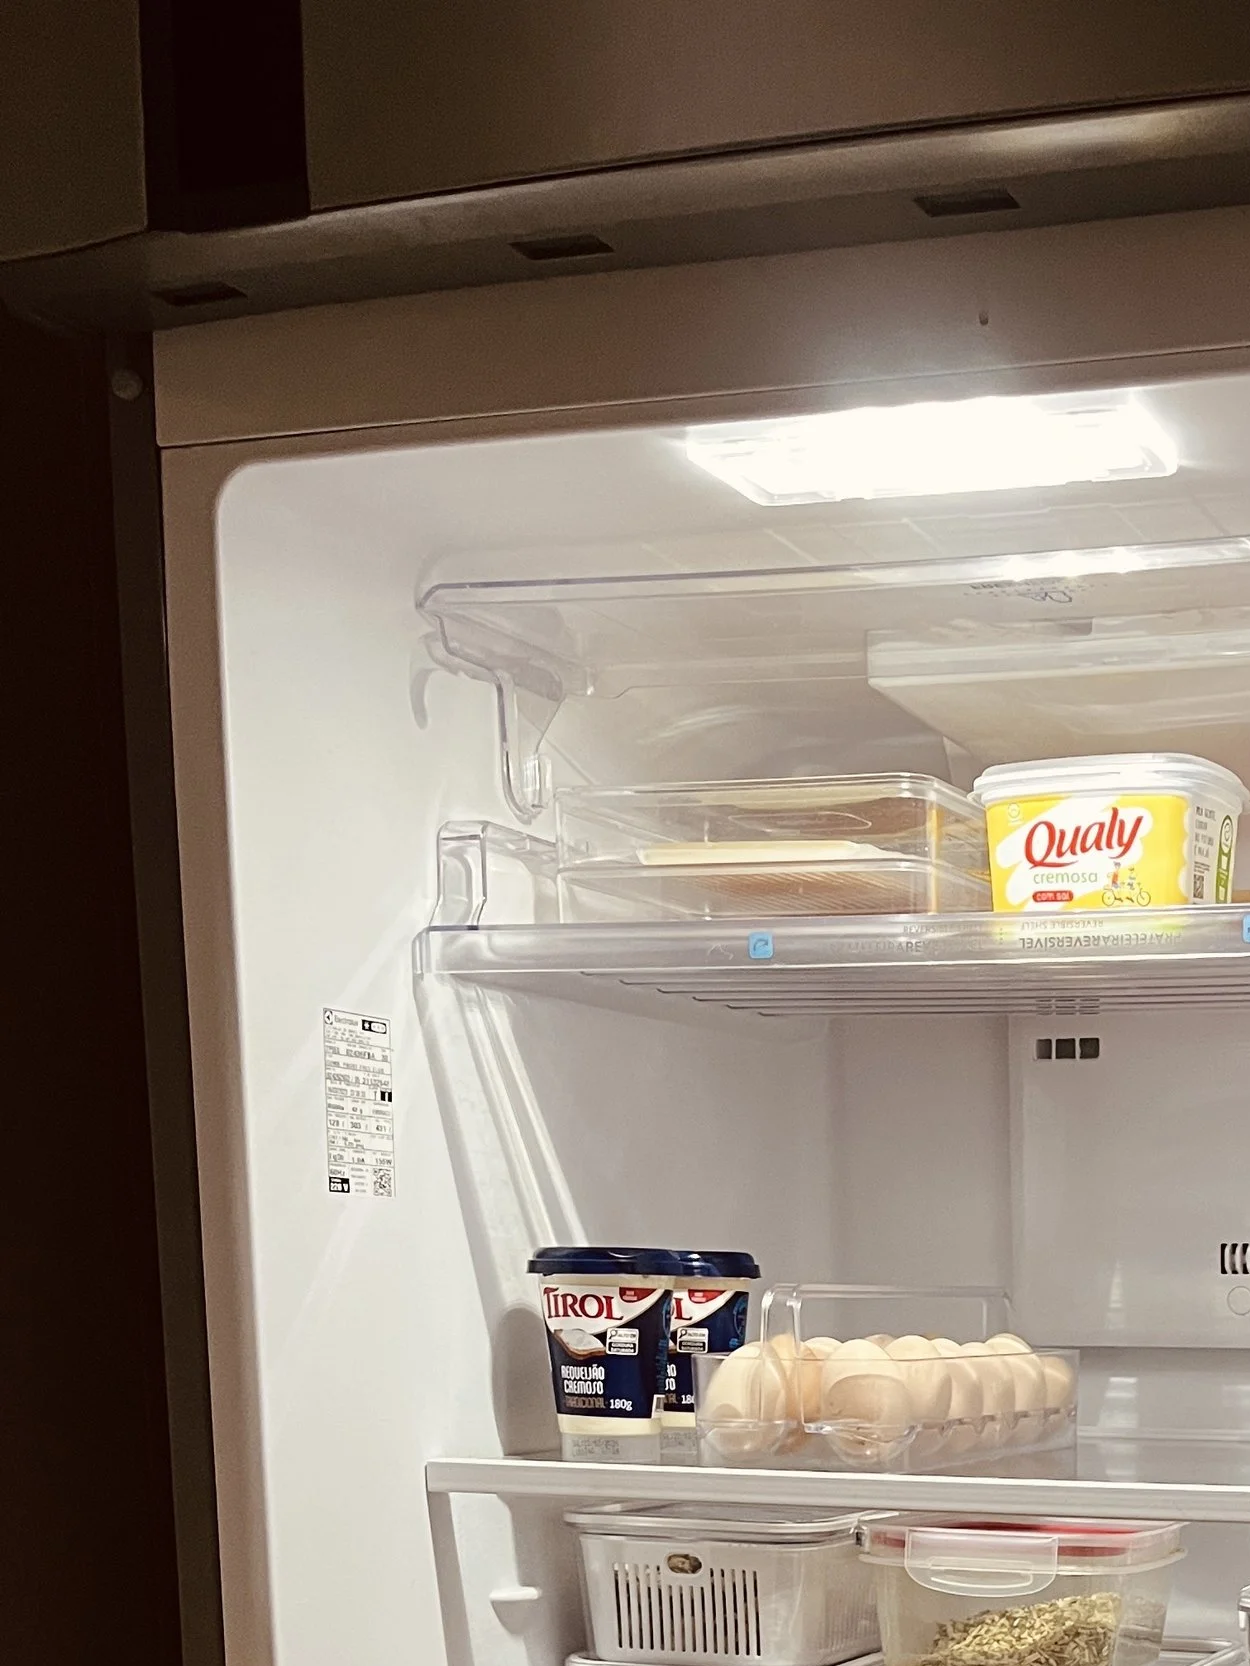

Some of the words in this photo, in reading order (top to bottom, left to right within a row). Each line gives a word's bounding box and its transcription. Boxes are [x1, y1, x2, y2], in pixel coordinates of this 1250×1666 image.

[1024, 806, 1144, 870] Qualy
[1033, 870, 1098, 885] cremosa
[543, 1286, 624, 1321] TIROL
[560, 1363, 606, 1381] REQUEIJÃO
[563, 1380, 604, 1395] CREMOSO
[609, 1398, 633, 1412] 180g
